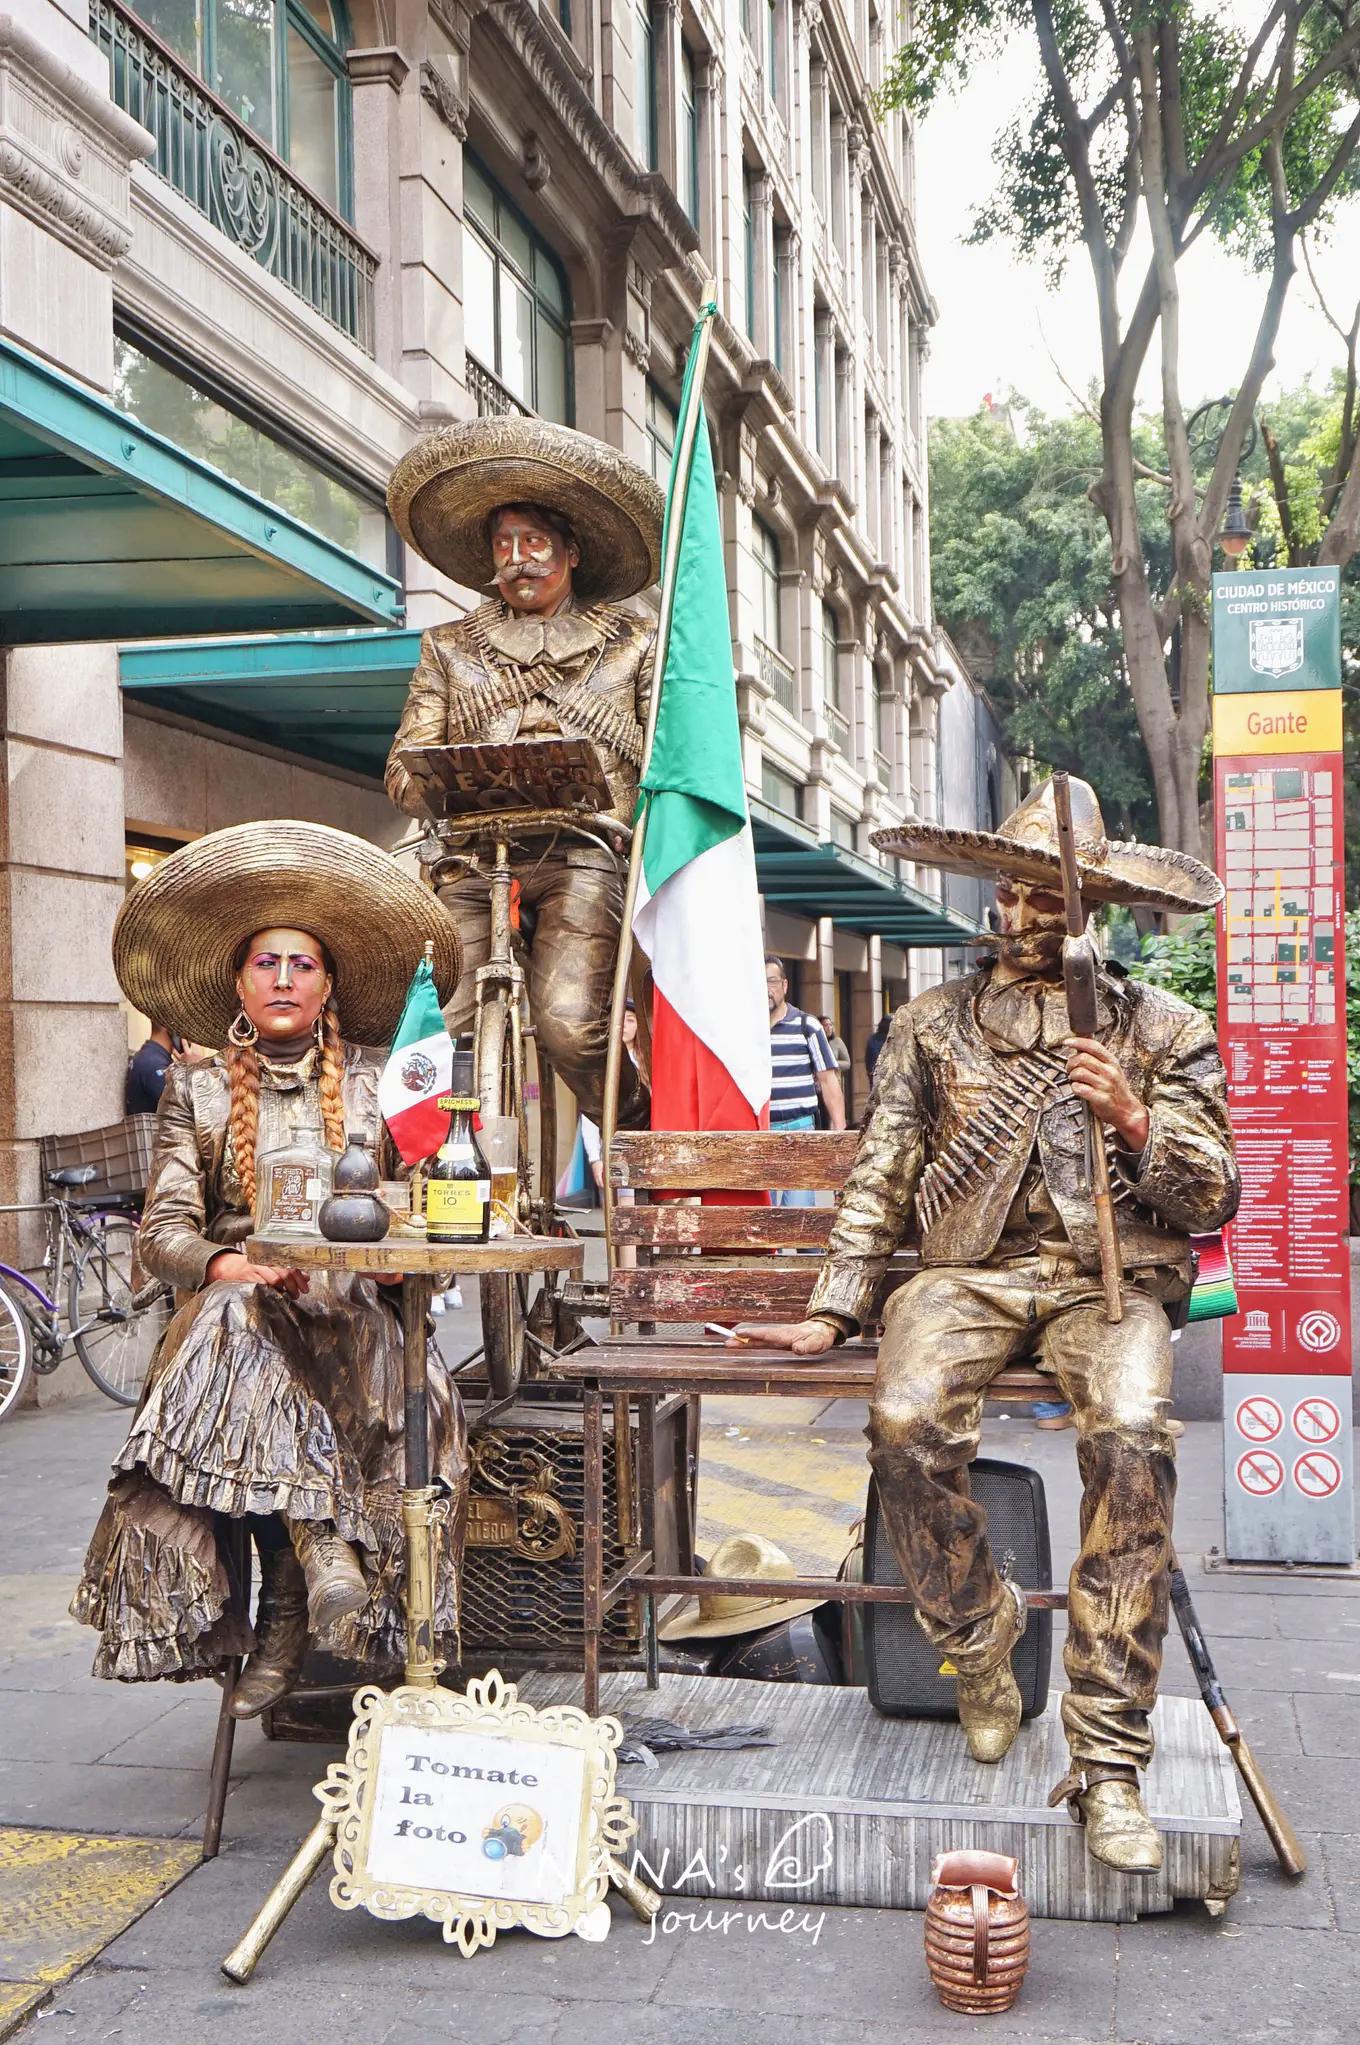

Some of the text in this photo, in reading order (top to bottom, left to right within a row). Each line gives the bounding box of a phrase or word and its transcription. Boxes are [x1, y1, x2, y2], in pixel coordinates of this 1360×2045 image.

[1216, 578, 1336, 600] CIUDAD DE MÉXICO
[1227, 597, 1326, 614] CENTRO HISTÓRICO
[1247, 711, 1308, 736] Gante
[443, 1196, 457, 1206] 10
[405, 1754, 539, 1787] Tomate
[399, 1785, 435, 1807] la
[392, 1819, 468, 1844] foto
